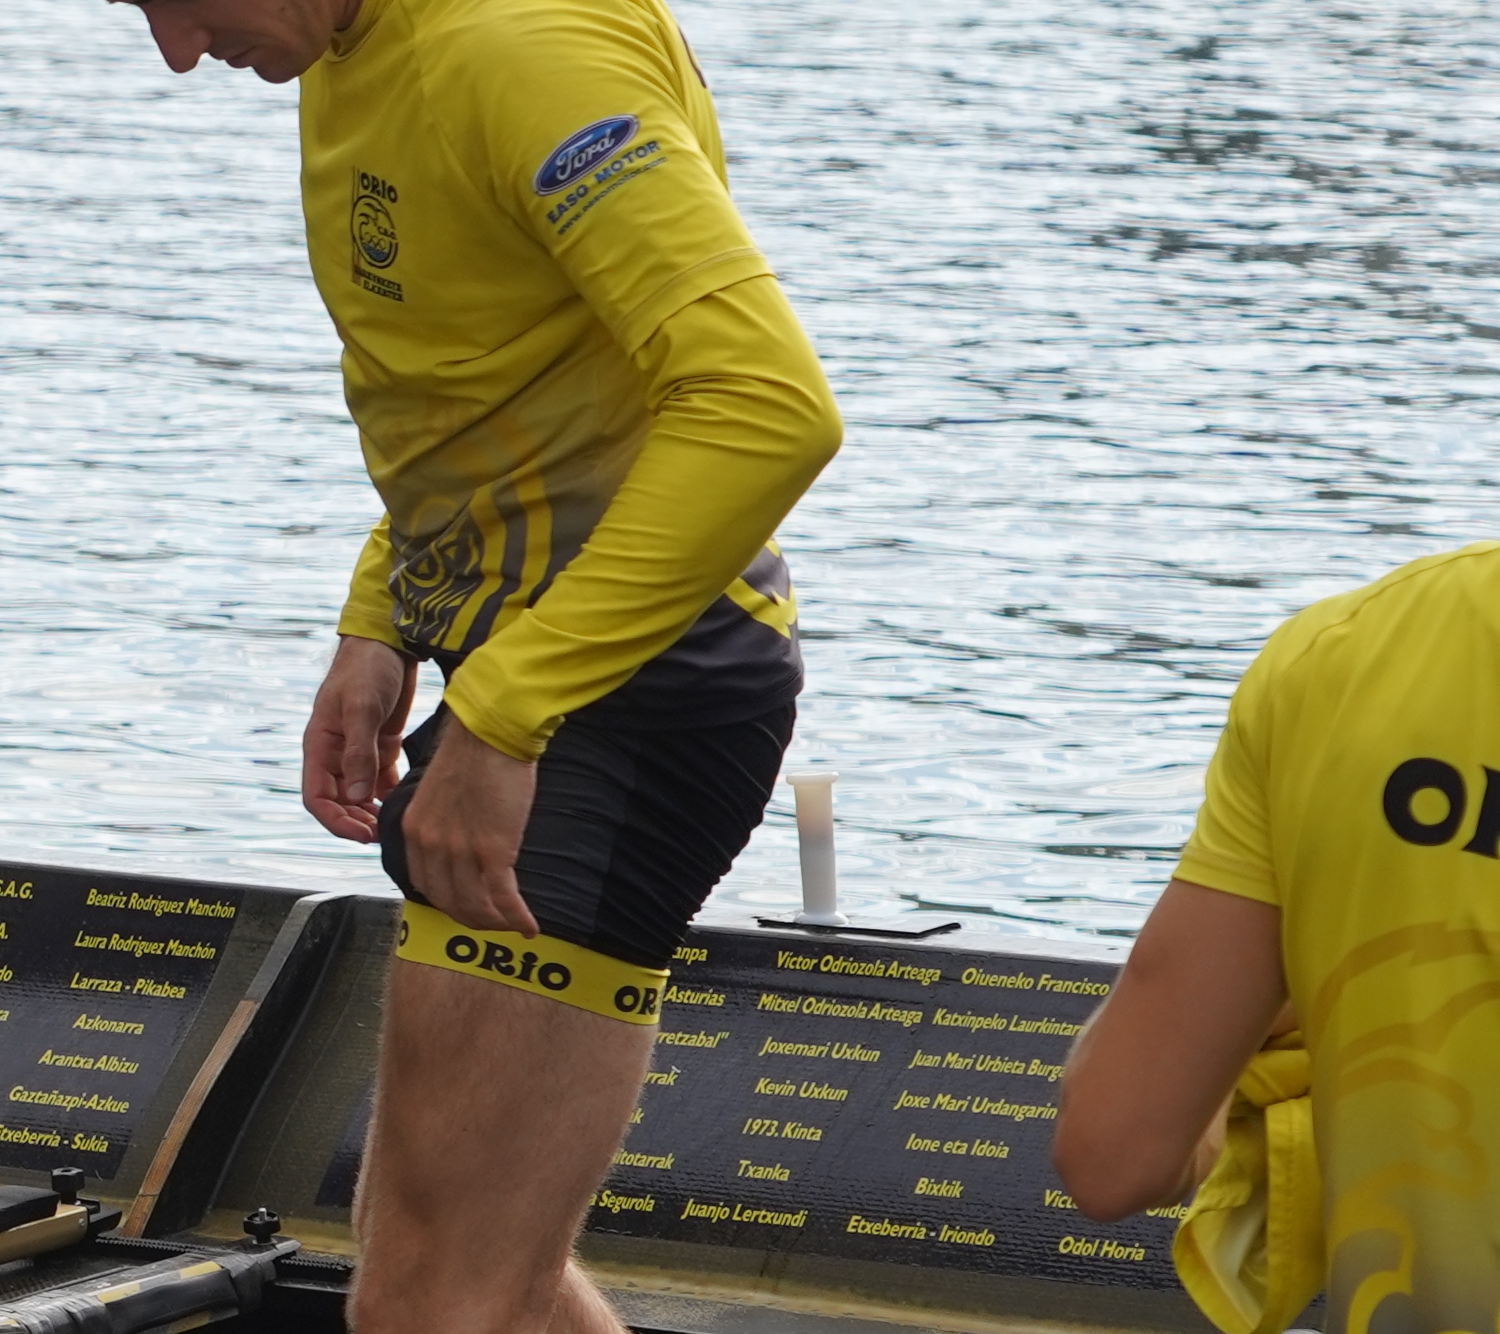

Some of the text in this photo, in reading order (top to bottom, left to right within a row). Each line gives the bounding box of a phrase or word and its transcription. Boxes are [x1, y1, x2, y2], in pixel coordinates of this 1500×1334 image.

[555, 128, 616, 180] Ford
[547, 140, 662, 225] EASO MOTOR
[86, 889, 126, 908] Beatriz
[185, 899, 235, 918] Manchón
[74, 931, 107, 949] Laura
[165, 939, 215, 960] Manchón
[820, 955, 941, 985] Odriozola Arteaga
[70, 972, 186, 999] Larraza Pikabea
[664, 985, 725, 1006] Asturias
[1036, 974, 1110, 997] Francisco
[757, 994, 922, 1027] Mitxel Odriozola Arteaga
[932, 1008, 1007, 1033] Katxinpeko
[73, 1014, 144, 1035] Azkonarra
[38, 1050, 139, 1074] Arantxa Albizu
[759, 1037, 880, 1062] Joxemari Uxkun
[908, 1049, 1026, 1074] Juan Mari Urbieta
[755, 1078, 848, 1101] Kevin Uxkun
[894, 1090, 1058, 1121] Joxe Mari Urdangarin
[71, 1133, 108, 1152] Sukia
[782, 1122, 822, 1141] Kinta
[905, 1134, 1009, 1158] Ione eta Idoia
[737, 1160, 790, 1181] Txanka
[915, 1177, 964, 1199] Bixkik
[599, 1190, 655, 1212] Segurola
[681, 1199, 808, 1227] Juanjo Lertxundi
[846, 1215, 995, 1247] Etxeberria Iriondo
[1059, 1236, 1145, 1261] Odol Horia
